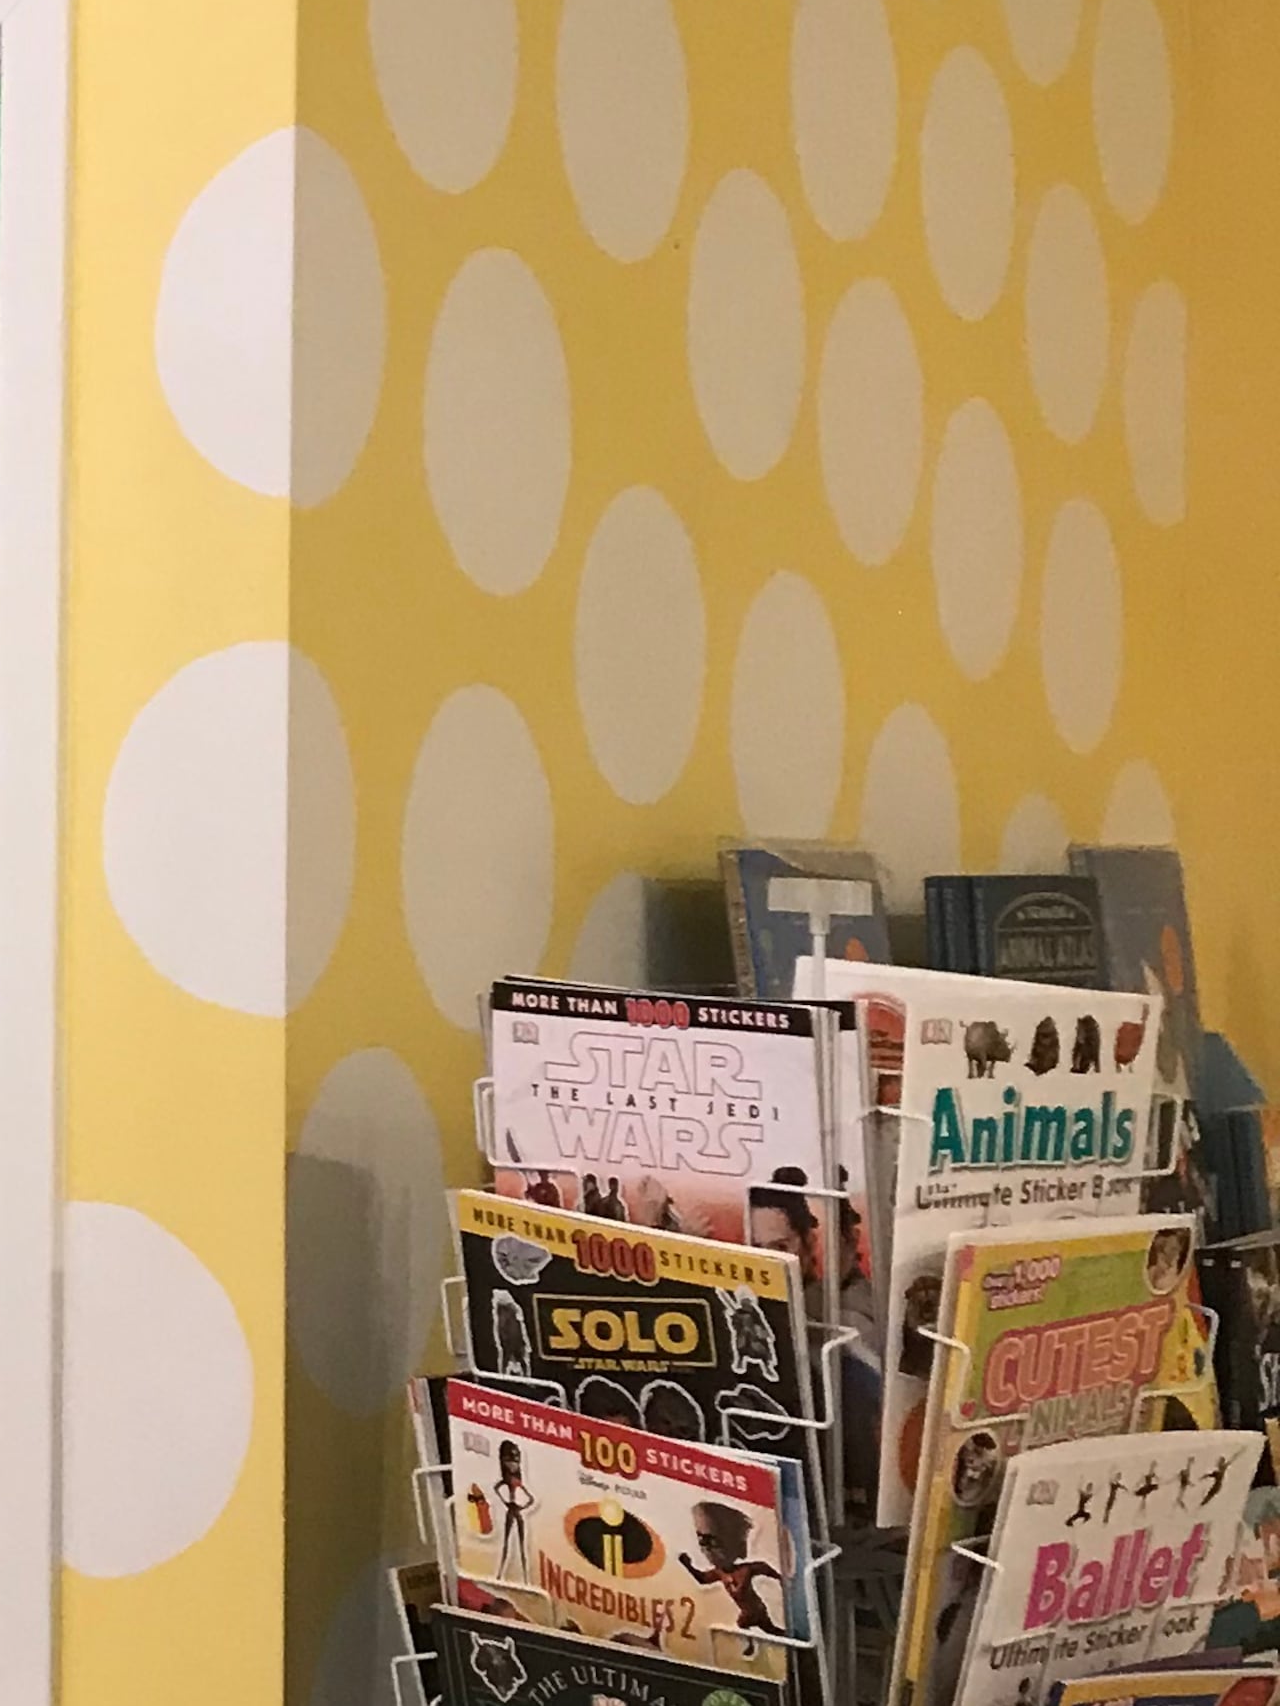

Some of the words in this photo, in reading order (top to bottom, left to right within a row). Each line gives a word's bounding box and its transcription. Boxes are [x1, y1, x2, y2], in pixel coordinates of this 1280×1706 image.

[511, 992, 560, 1011] MORE
[567, 996, 618, 1016] THAN
[625, 998, 690, 1029] 1000
[697, 1007, 790, 1030] STICKERS
[531, 1083, 580, 1103] THE
[606, 1092, 679, 1114] LAST
[705, 1101, 779, 1121] JEDI
[544, 1031, 763, 1101] STAR
[546, 1103, 765, 1178] WARS
[930, 1086, 1136, 1168] Animals
[1021, 1179, 1087, 1205] Sticker
[473, 1207, 515, 1233] MORE
[523, 1220, 566, 1246] THAN
[571, 1231, 659, 1285] 1000
[659, 1249, 771, 1287] STICKERS
[549, 1307, 700, 1354] SOLO
[986, 1300, 1175, 1414] CUTEST
[462, 1396, 515, 1426] MORE
[520, 1412, 573, 1442] THAN
[579, 1430, 638, 1475] 100
[645, 1447, 748, 1493] STICKERS
[539, 1550, 677, 1635] INCREDIBLES
[679, 1597, 698, 1641] 2
[1024, 1522, 1206, 1631] Ballet
[1083, 1622, 1147, 1653] Sticker
[1160, 1612, 1199, 1639] ook
[528, 1670, 568, 1706] THE
